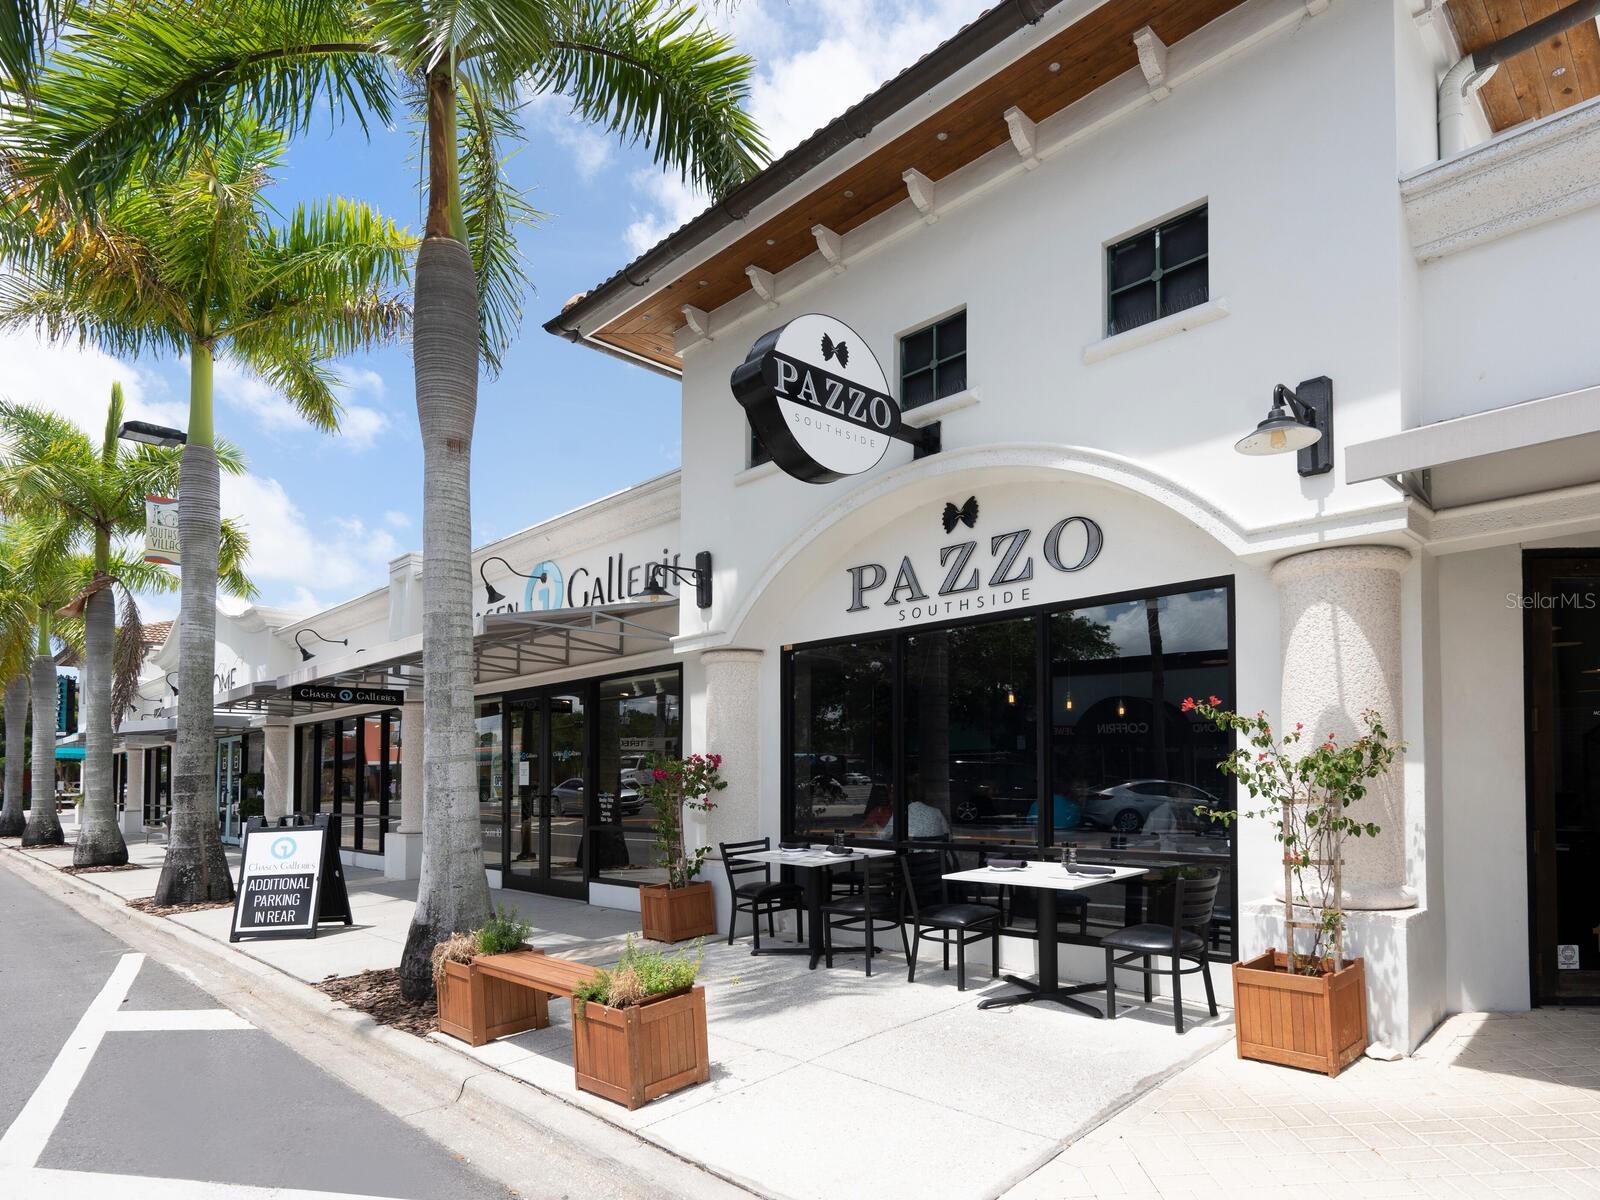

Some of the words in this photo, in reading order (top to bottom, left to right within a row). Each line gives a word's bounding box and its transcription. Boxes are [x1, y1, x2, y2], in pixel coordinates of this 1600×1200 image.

[773, 357, 892, 429] PAZZO
[794, 412, 875, 448] SOUTHSIDE
[846, 516, 1104, 613] PAZZO
[898, 588, 1032, 621] SOUTHSIDE
[248, 877, 310, 891] ADDITIONAL
[254, 893, 301, 907] PARKING
[254, 911, 265, 924] IN
[267, 909, 296, 923] REAR
